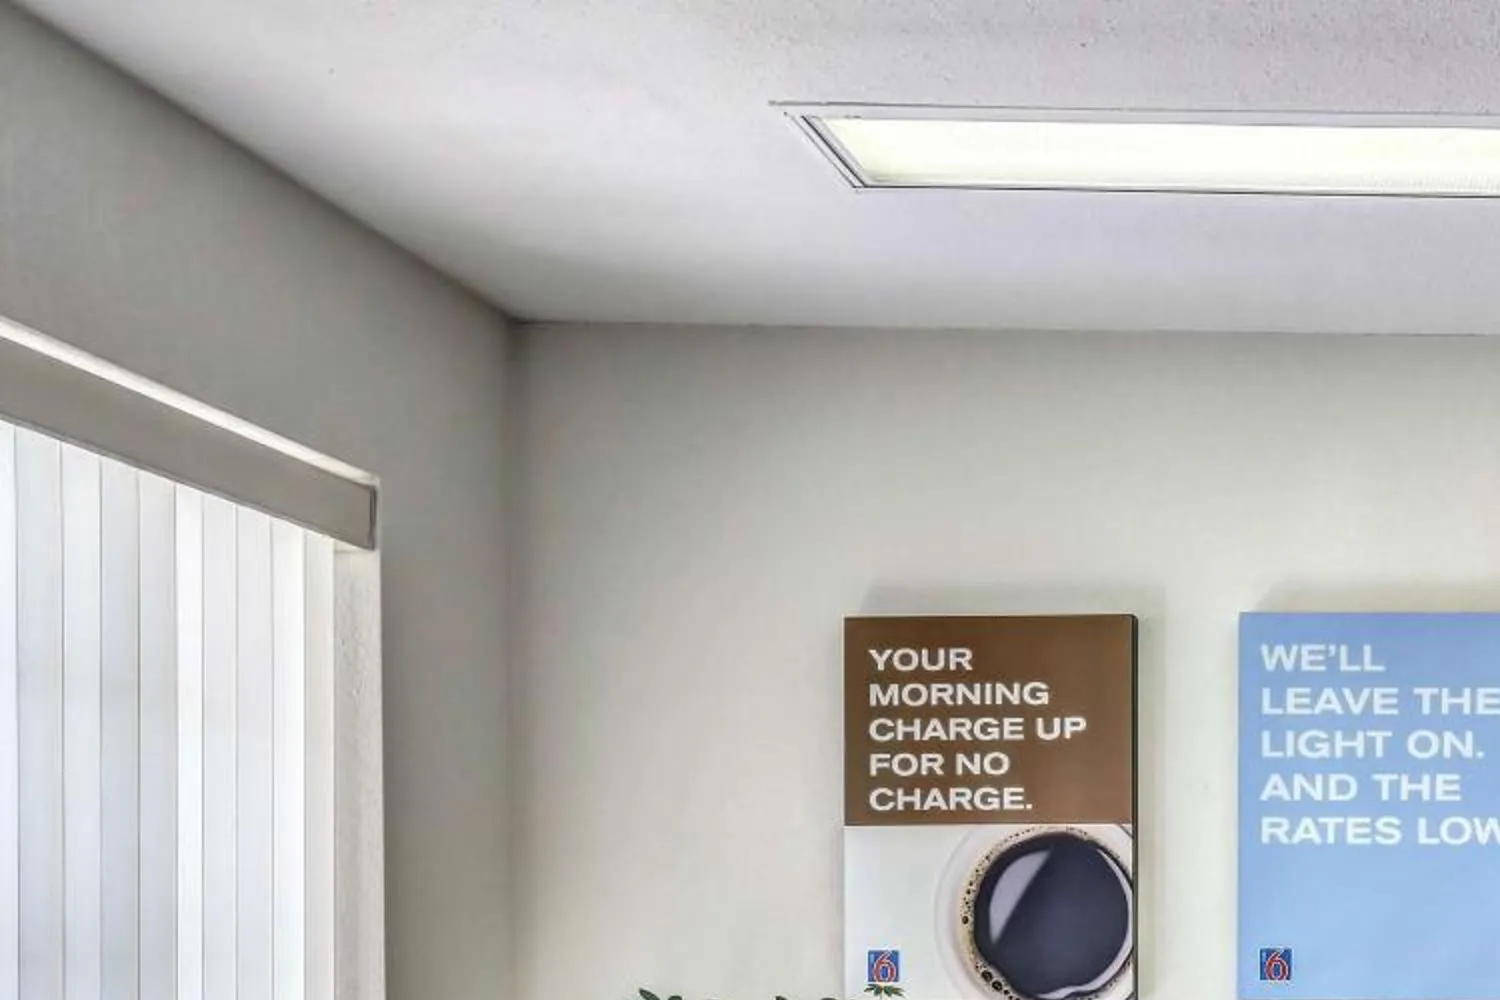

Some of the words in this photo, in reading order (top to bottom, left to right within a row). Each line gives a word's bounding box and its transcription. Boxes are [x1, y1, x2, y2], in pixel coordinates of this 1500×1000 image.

[868, 647, 973, 672] YOUR
[1261, 644, 1385, 671] WE'LL
[868, 681, 1049, 707] MORNING
[1261, 687, 1399, 715] LEAVE
[868, 716, 1025, 742] CHARGE
[1036, 716, 1087, 741] UP
[1261, 729, 1393, 759] LIGHT
[1407, 729, 1484, 759] ON.
[868, 752, 945, 777] FOR
[955, 751, 1010, 776] NO
[868, 786, 1033, 811] CHARGE.
[1260, 773, 1358, 802] AND
[1372, 773, 1462, 802] THE
[1260, 816, 1403, 846] RATES
[873, 949, 897, 983] 6
[1265, 949, 1289, 982] 6
